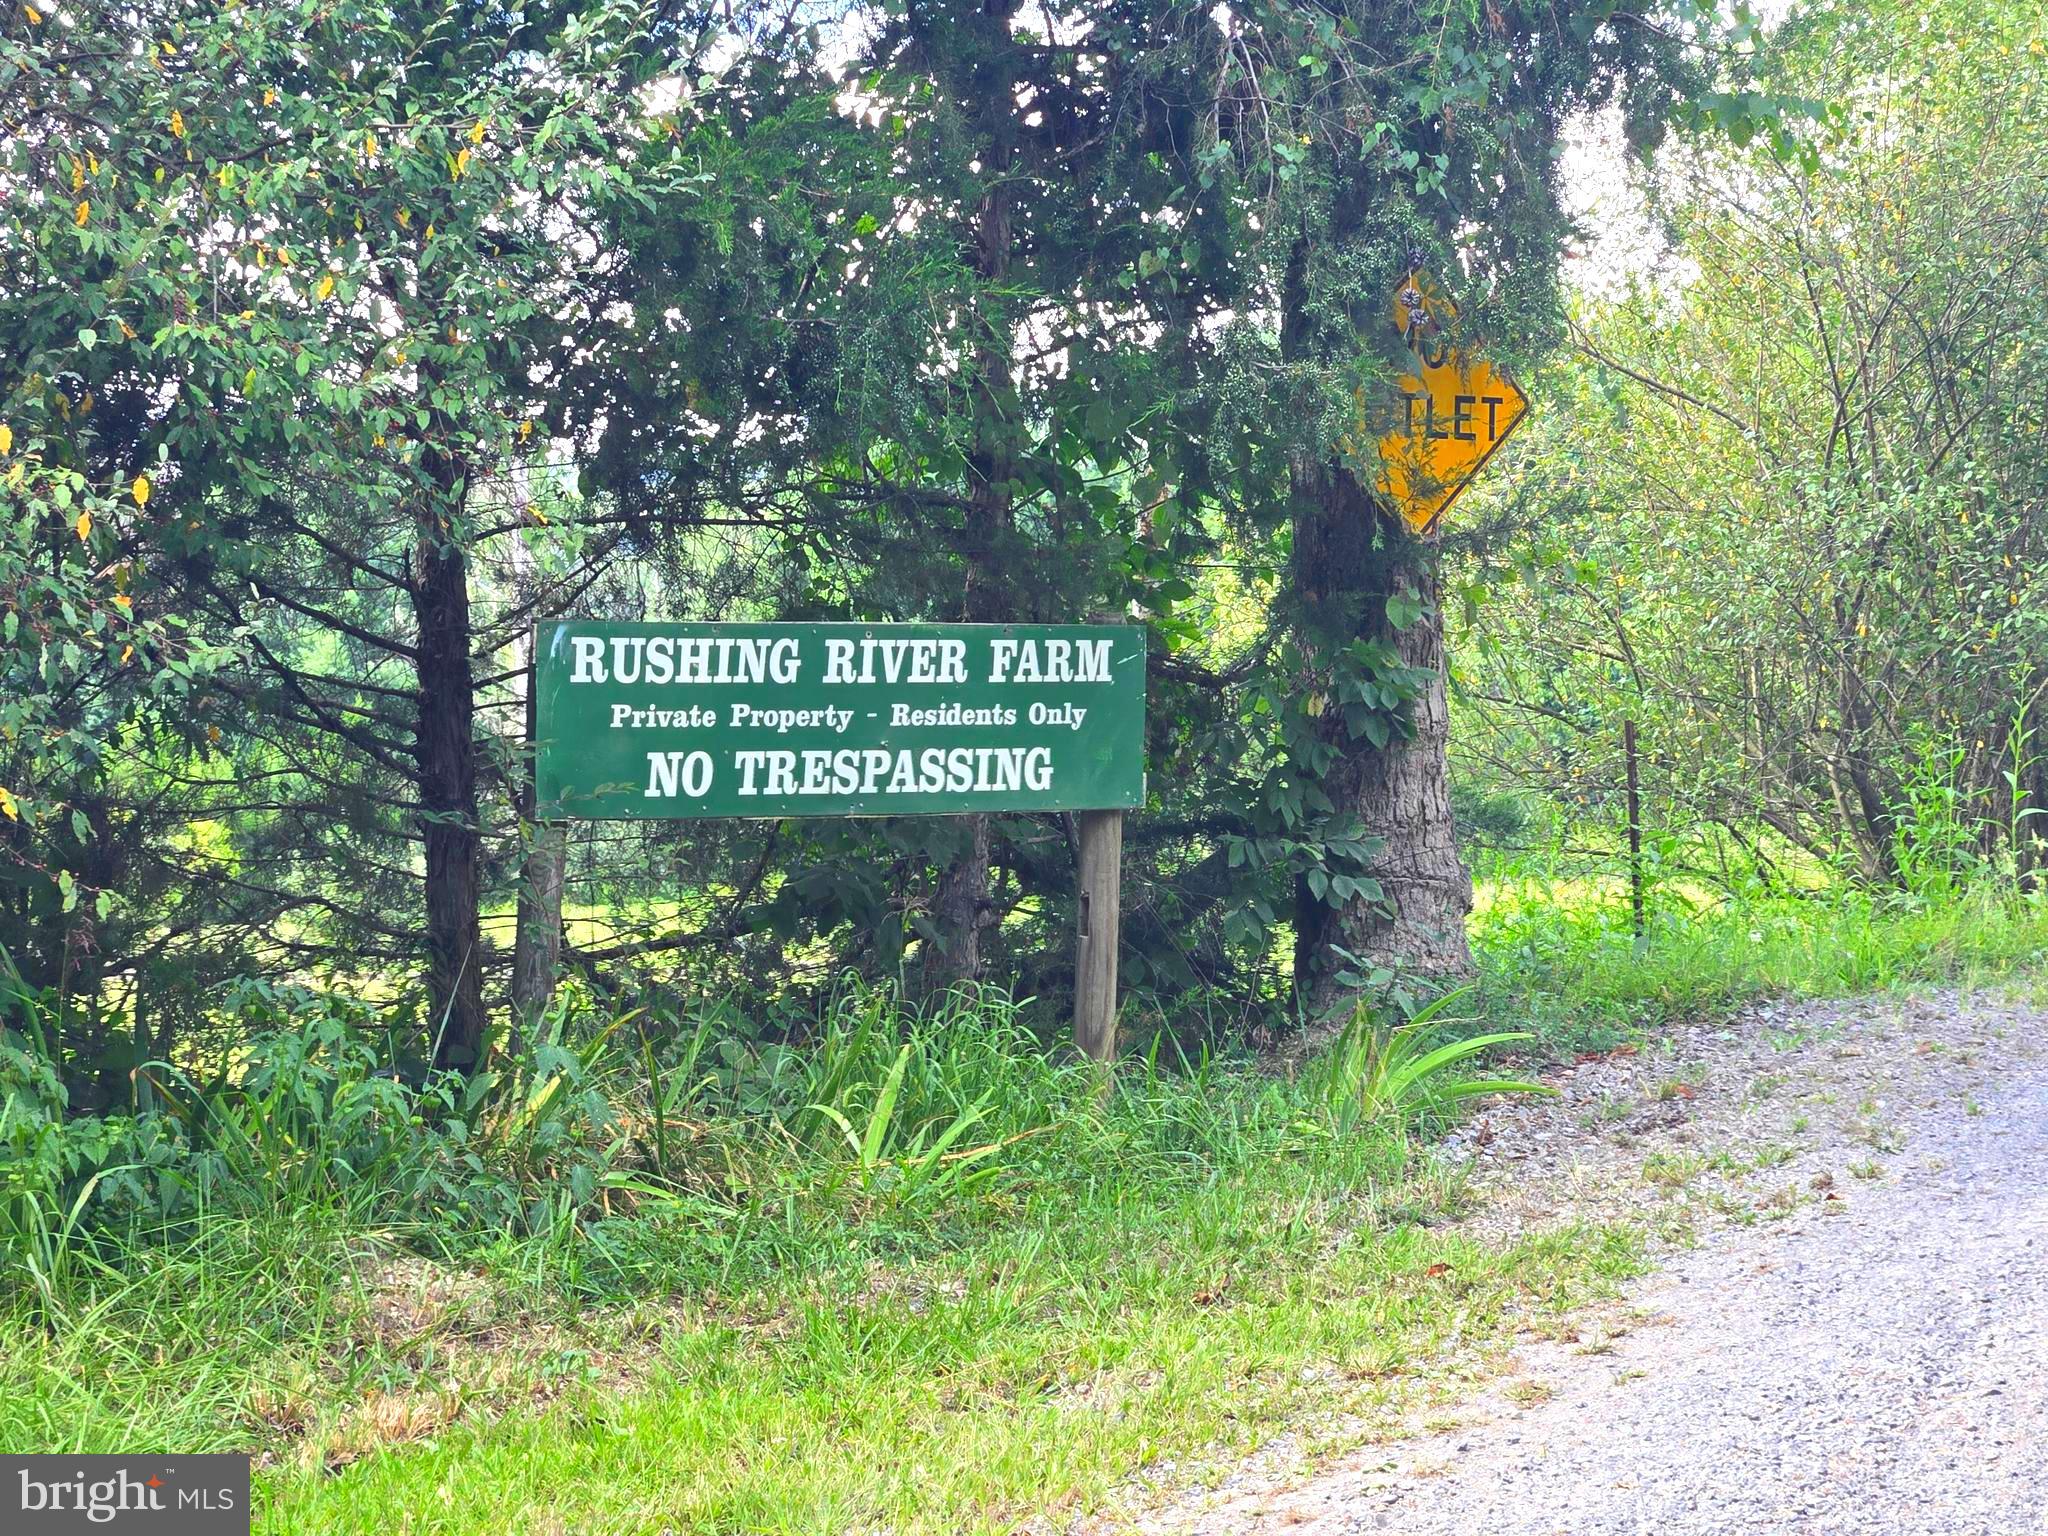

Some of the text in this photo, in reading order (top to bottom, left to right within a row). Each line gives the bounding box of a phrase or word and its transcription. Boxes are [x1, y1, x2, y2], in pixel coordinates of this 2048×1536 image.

[569, 636, 1115, 685] RUSHING RIVER FARM
[609, 703, 717, 728] Private
[729, 703, 855, 734] Property
[889, 702, 1017, 727] Residents
[1028, 702, 1088, 731] Only
[644, 746, 1055, 798] NO TRESPASSING
